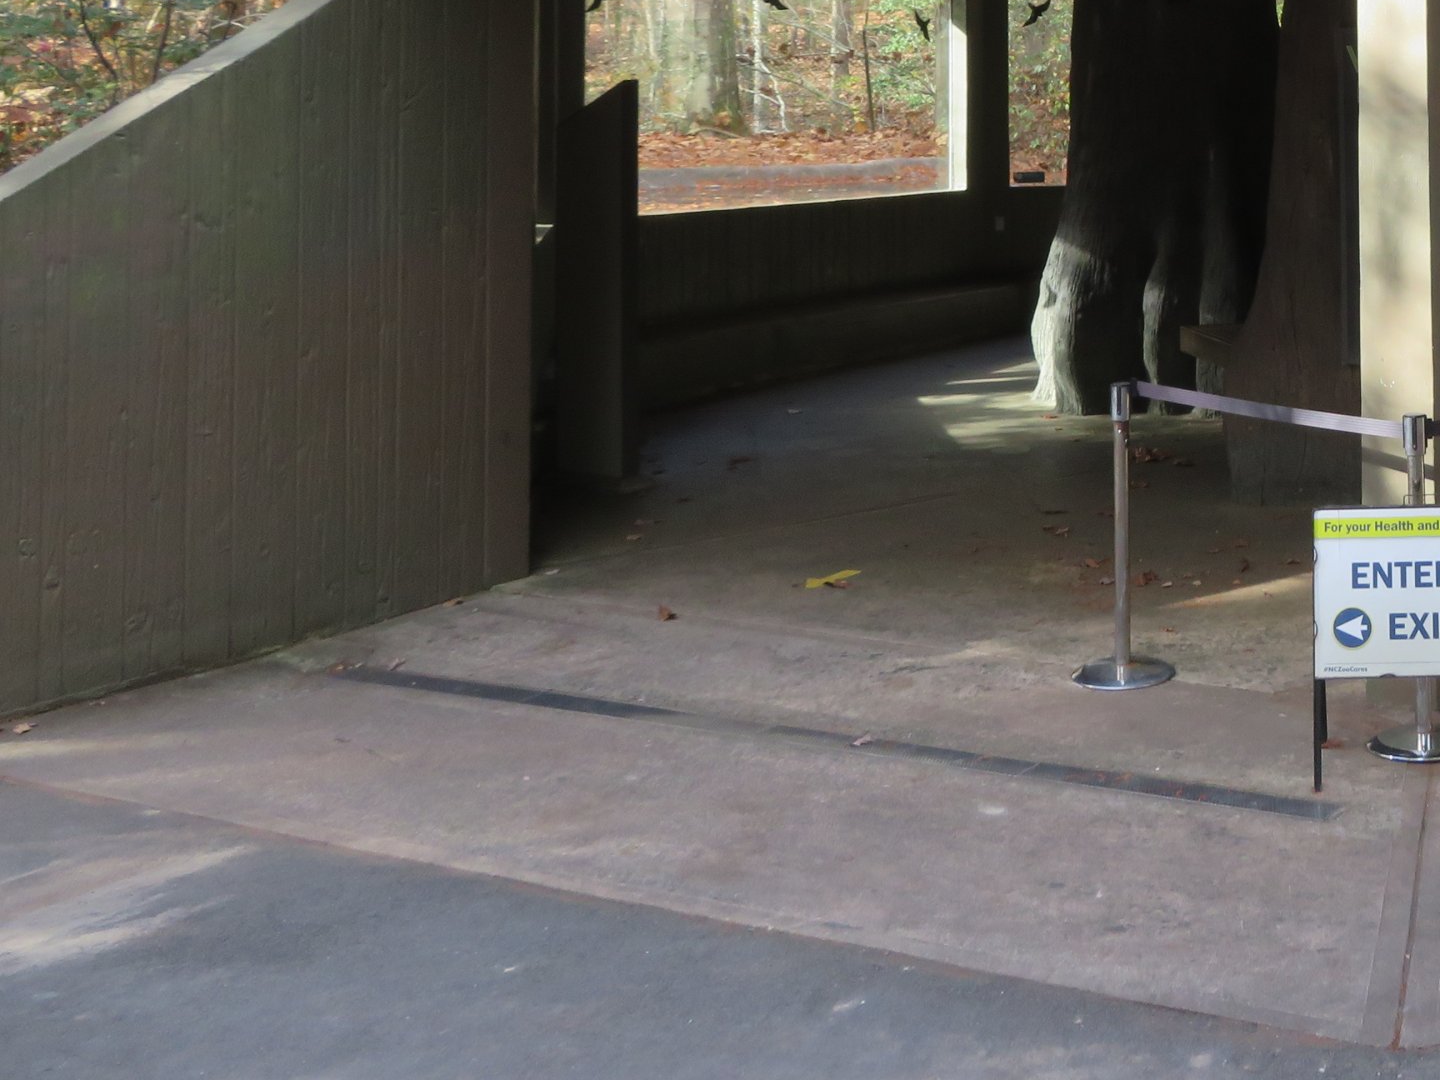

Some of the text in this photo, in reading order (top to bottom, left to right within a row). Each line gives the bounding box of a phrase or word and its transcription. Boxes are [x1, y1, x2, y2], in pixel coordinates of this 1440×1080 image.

[1324, 521, 1342, 533] For
[1346, 523, 1371, 534] your
[1374, 520, 1414, 532] Health
[1417, 520, 1440, 531] and
